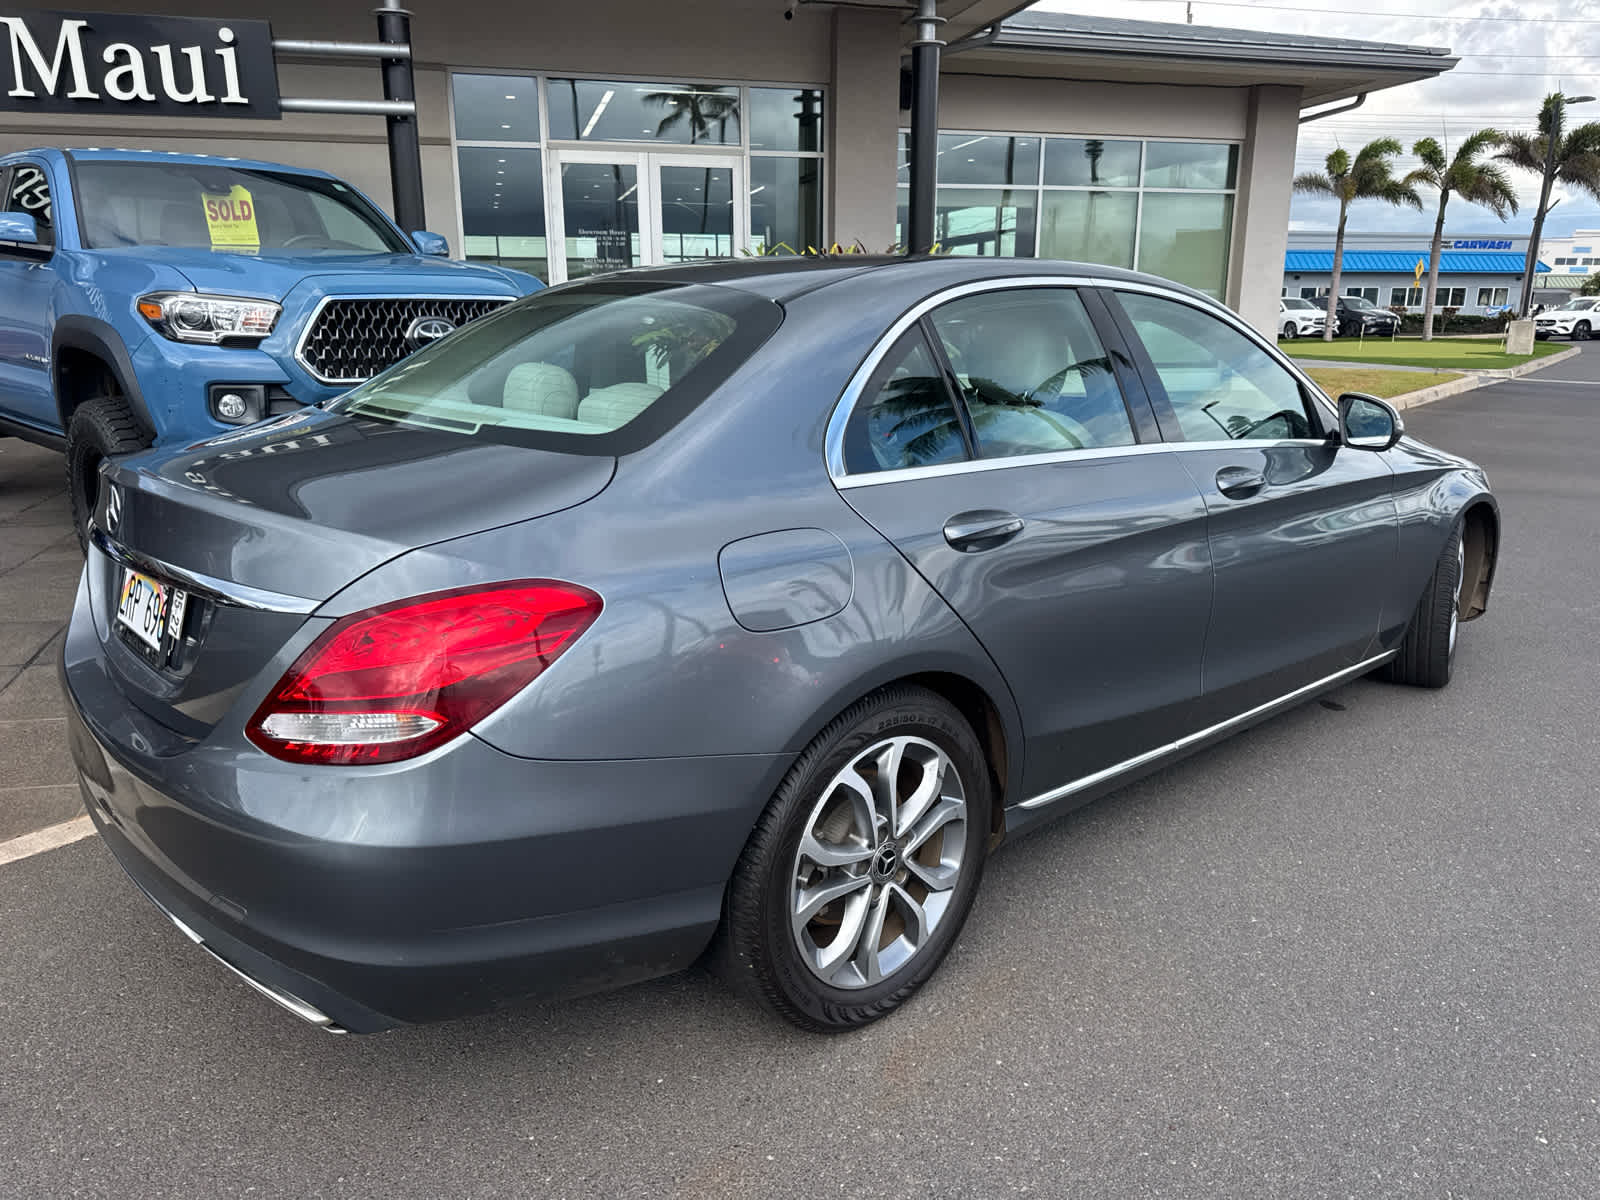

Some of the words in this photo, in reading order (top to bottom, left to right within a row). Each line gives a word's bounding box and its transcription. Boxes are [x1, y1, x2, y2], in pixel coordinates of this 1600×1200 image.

[0, 16, 249, 104] Maui
[207, 199, 252, 222] SOLD
[1453, 240, 1512, 249] CARWASH
